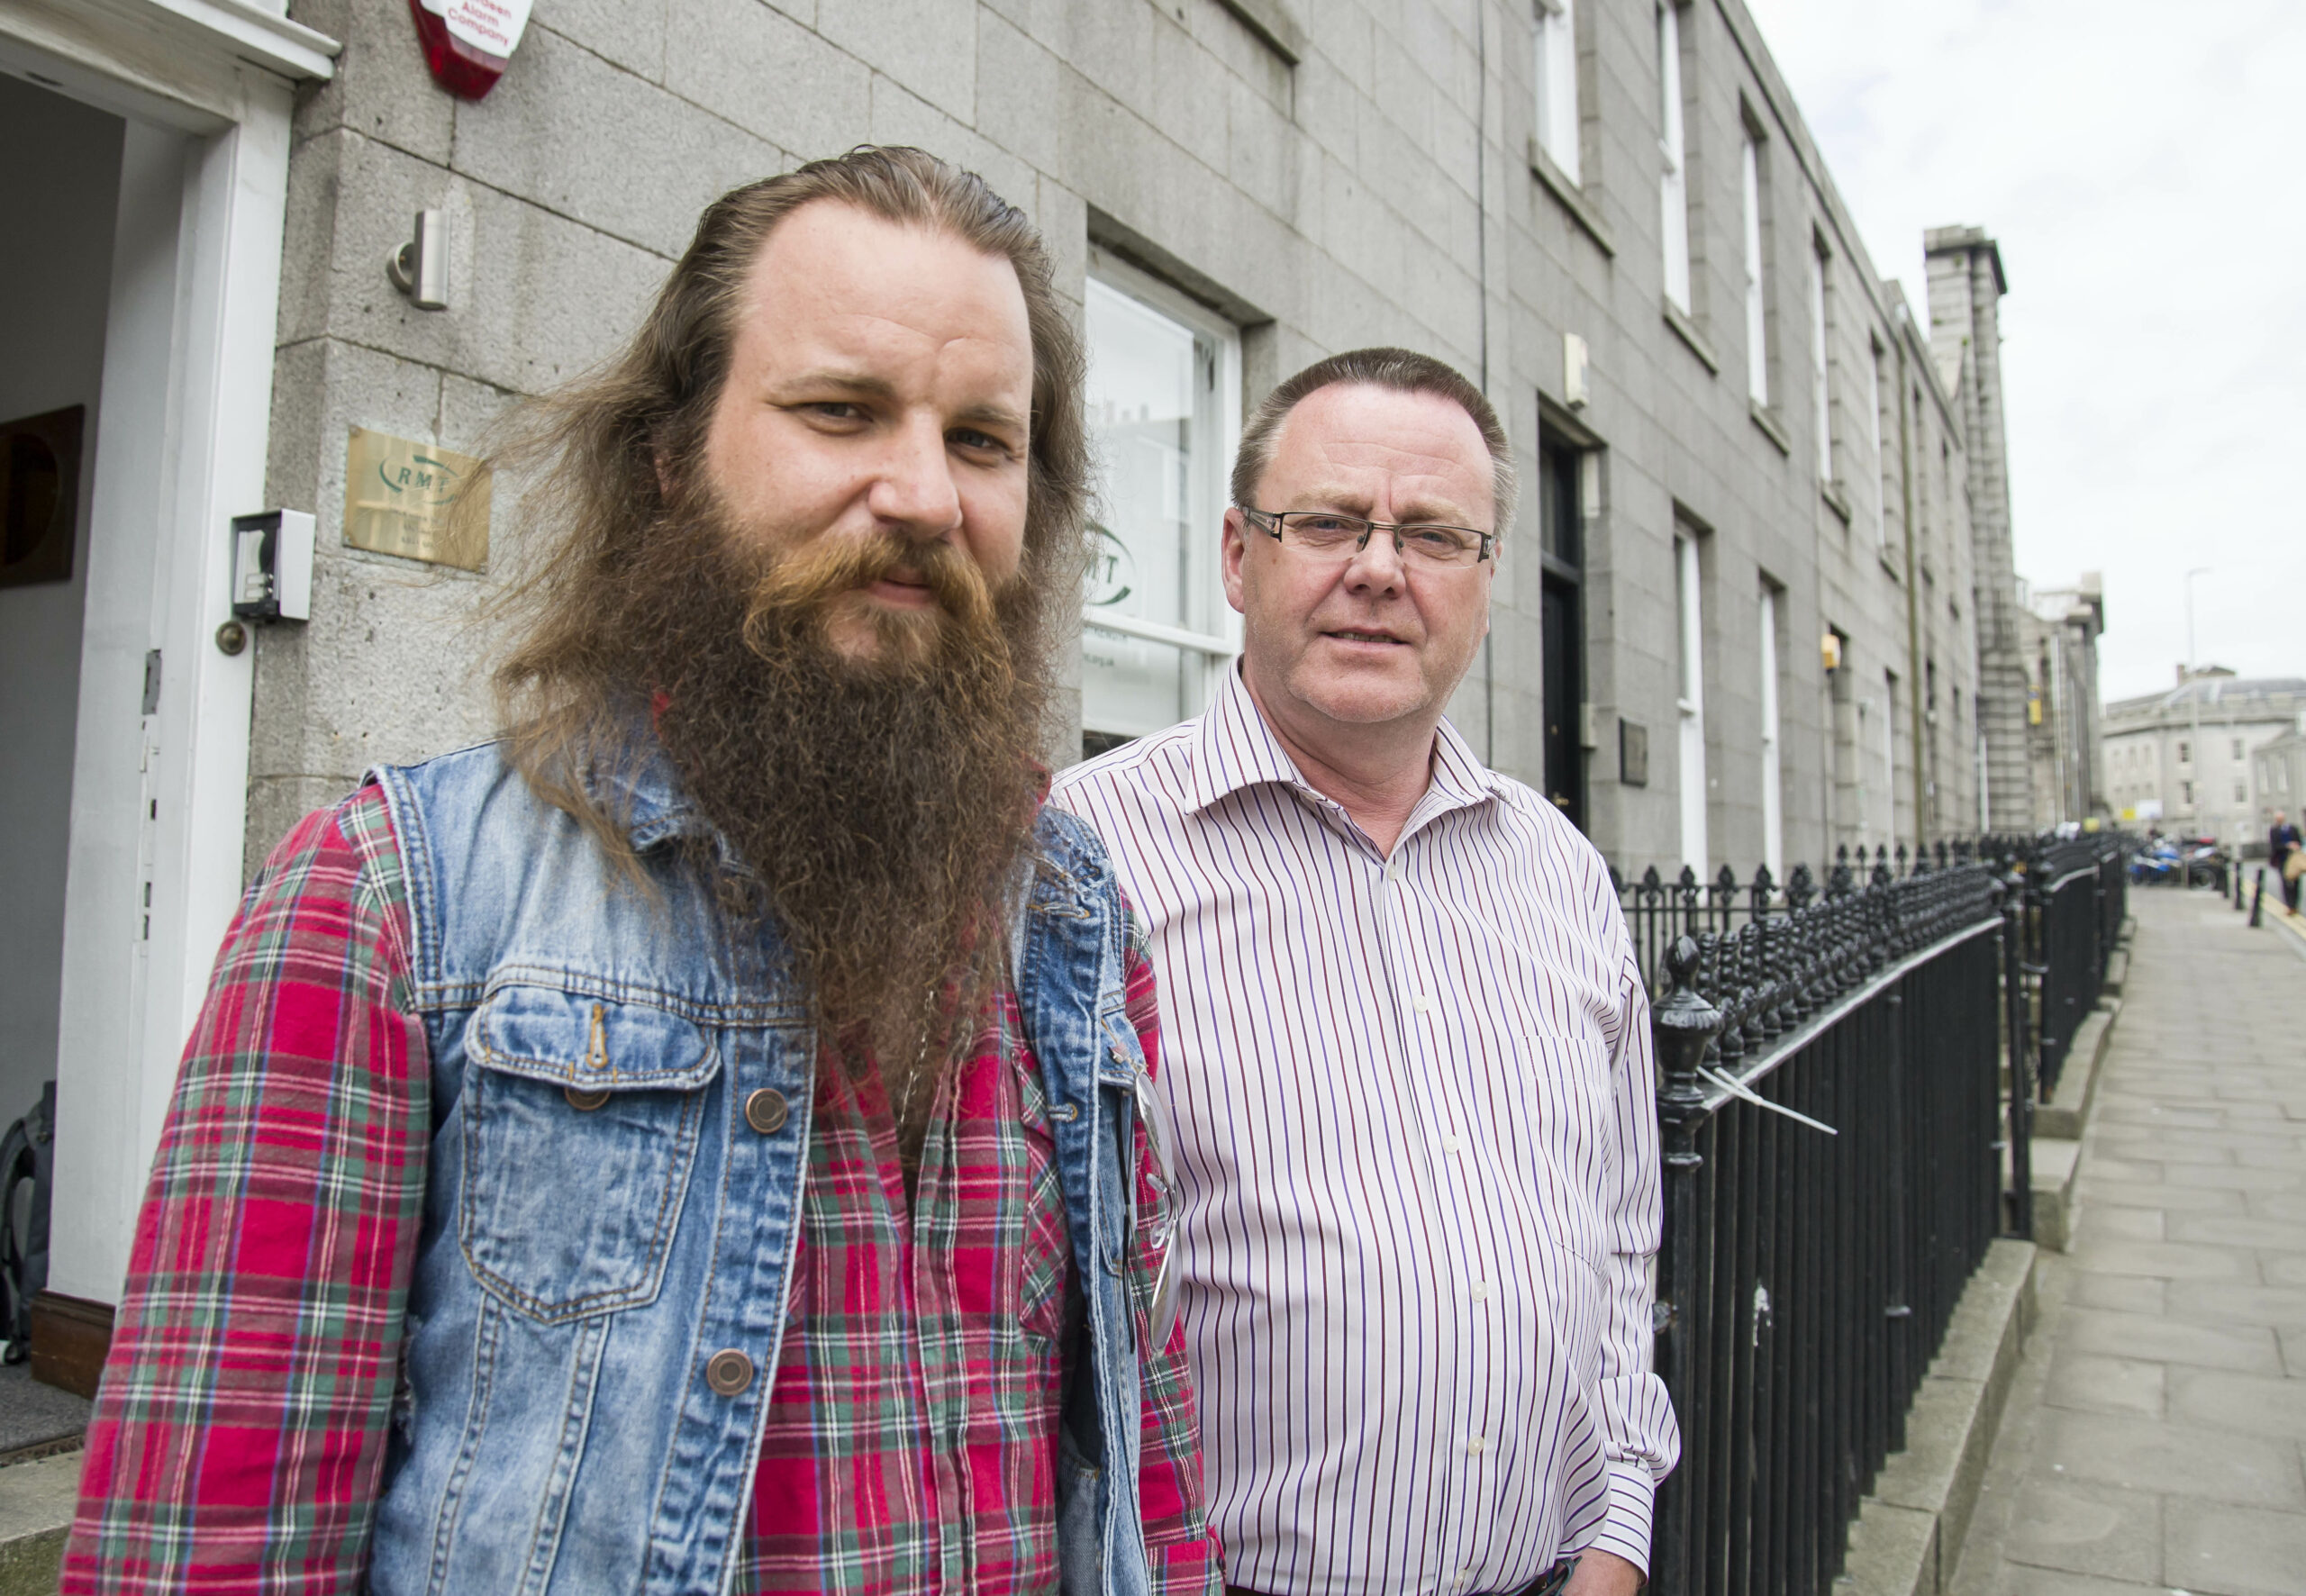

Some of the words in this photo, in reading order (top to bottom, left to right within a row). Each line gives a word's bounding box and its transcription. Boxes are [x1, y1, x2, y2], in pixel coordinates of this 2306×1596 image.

[462, 2, 499, 27] Alarm
[477, 0, 512, 19] deen
[449, 7, 507, 46] Company
[397, 466, 449, 494] RMT
